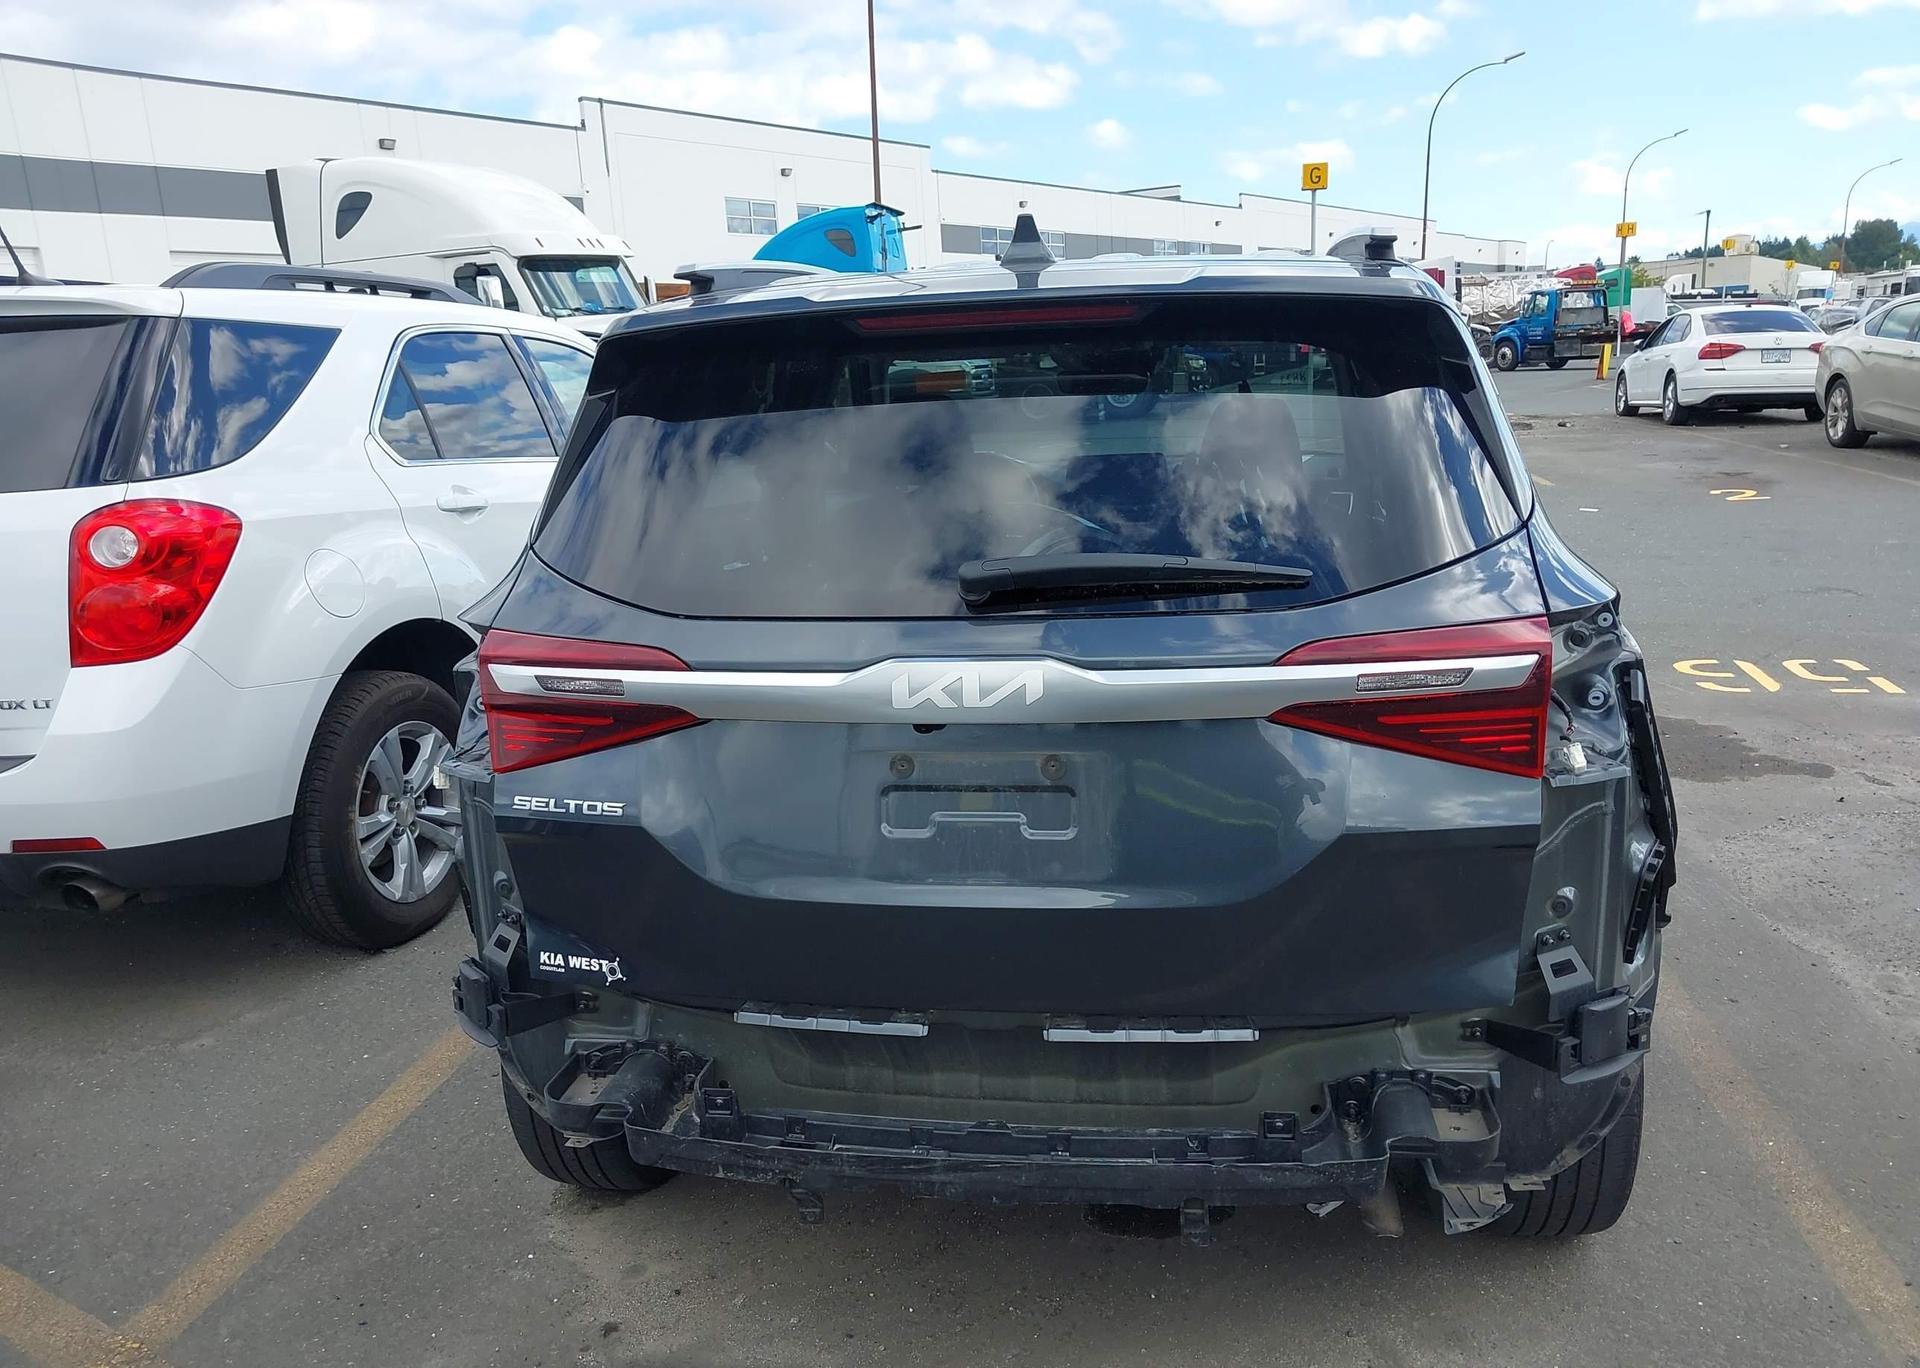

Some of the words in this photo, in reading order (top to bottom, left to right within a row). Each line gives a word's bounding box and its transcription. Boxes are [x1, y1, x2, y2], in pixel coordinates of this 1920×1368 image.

[1309, 166, 1322, 185] G
[1709, 488, 1772, 501] 2
[890, 669, 1045, 709] KIA
[32, 697, 54, 710] LT
[511, 795, 628, 817] SELTOS
[539, 951, 565, 967] KIA
[567, 954, 609, 973] WEST
